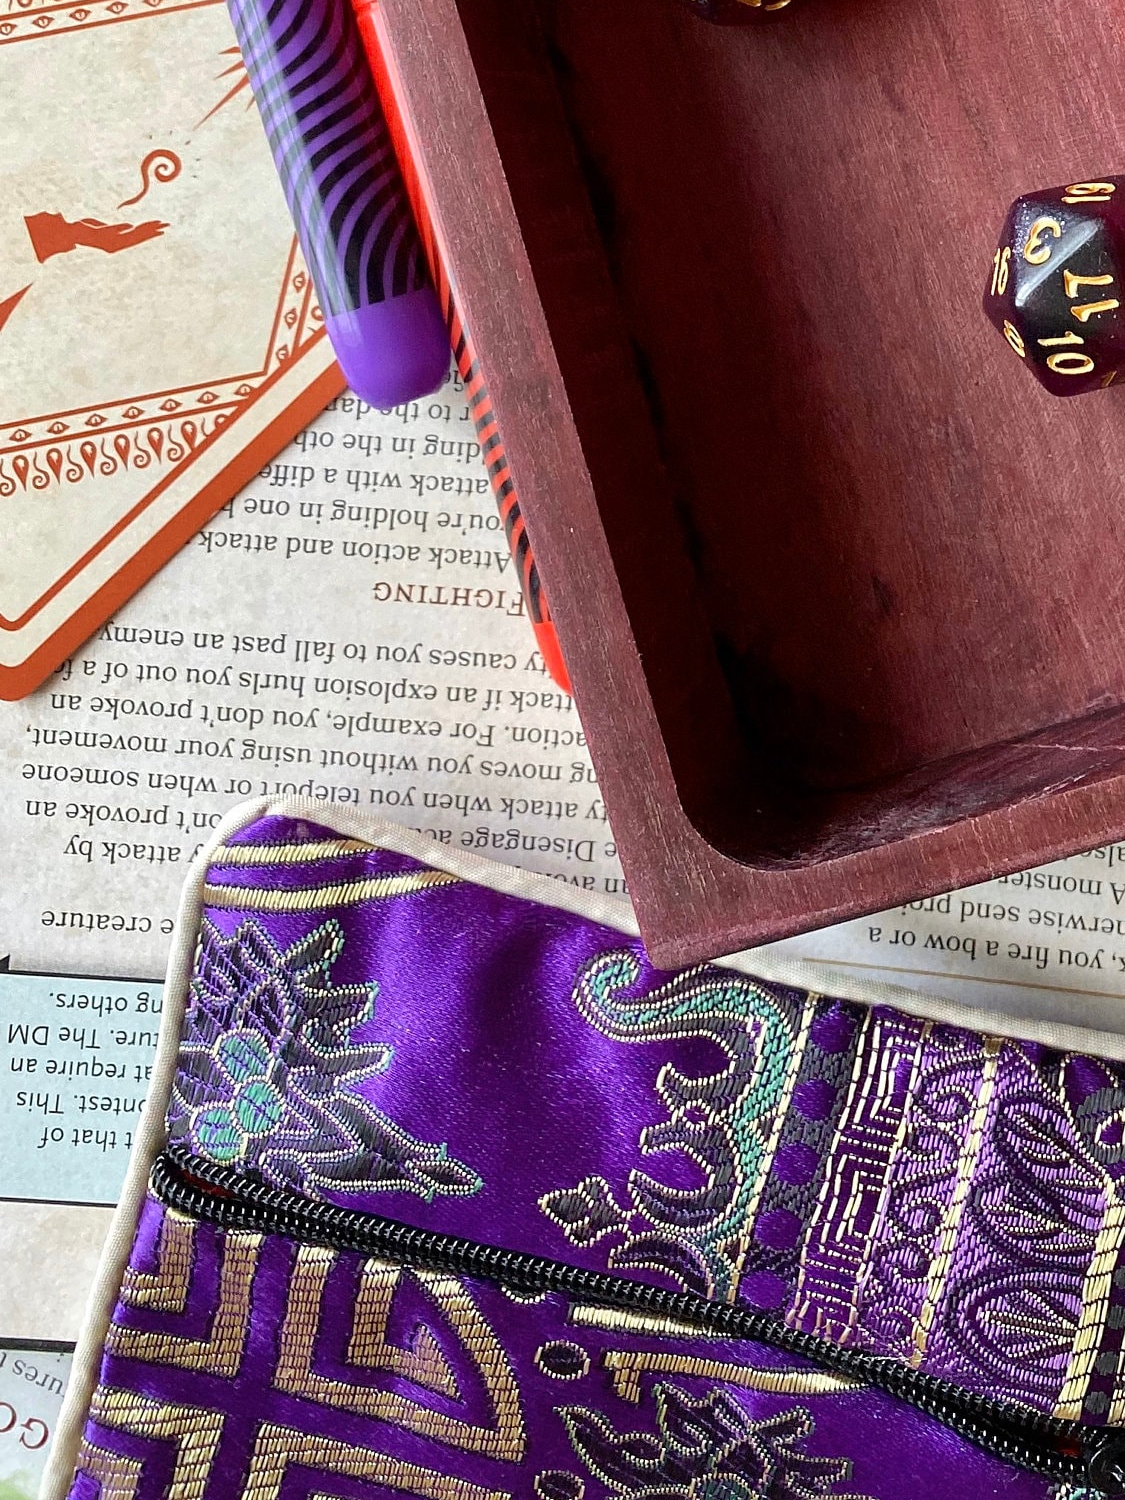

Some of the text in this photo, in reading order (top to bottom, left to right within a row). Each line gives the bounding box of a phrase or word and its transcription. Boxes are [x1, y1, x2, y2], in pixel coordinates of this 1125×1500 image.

[1023, 217, 1061, 264] 3
[1064, 269, 1119, 322] 17
[1037, 331, 1094, 375] 10
[90, 697, 495, 747] For example, you don't provoke
[27, 725, 418, 775] without using your movement,
[63, 835, 181, 864] attack by
[42, 911, 151, 932] creature
[869, 927, 882, 942] a
[889, 930, 916, 946] or
[923, 934, 976, 961] bow
[986, 941, 999, 956] a
[1008, 943, 1049, 969] fire
[1059, 949, 1104, 969] you
[50, 993, 127, 1017] others.
[8, 1024, 100, 1050] The DM
[11, 1056, 126, 1081] require an
[17, 1092, 64, 1115] This
[37, 1127, 117, 1152] that of
